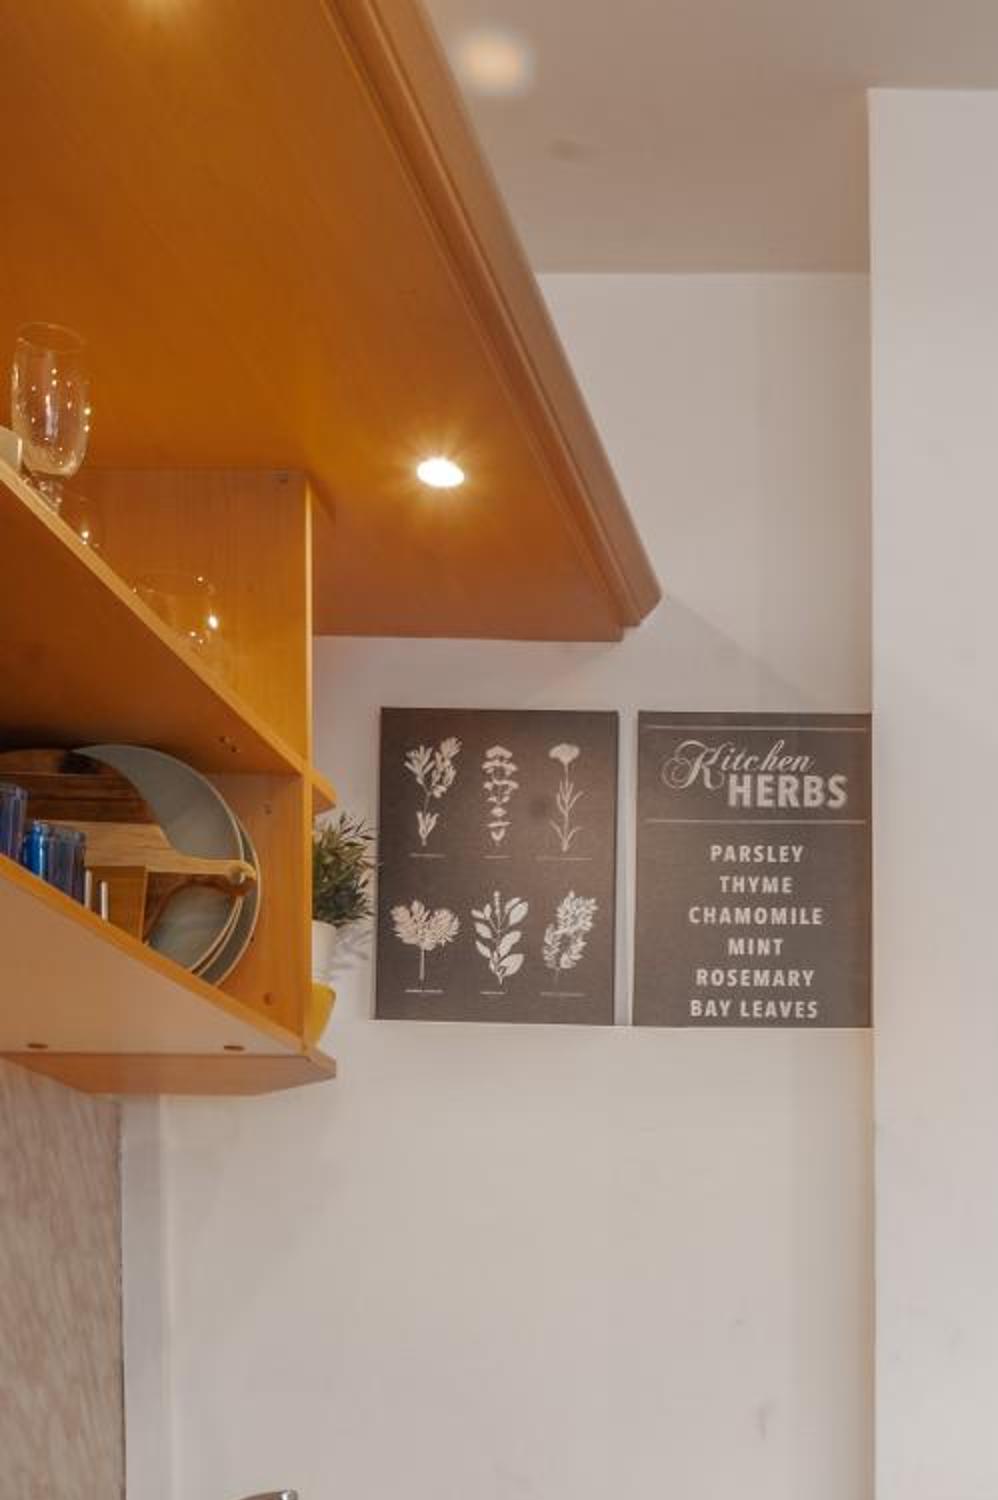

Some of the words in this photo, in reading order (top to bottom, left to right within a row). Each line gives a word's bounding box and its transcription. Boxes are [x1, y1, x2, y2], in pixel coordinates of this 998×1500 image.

[662, 739, 814, 790] Kitchen
[728, 774, 848, 808] HERBS
[710, 844, 804, 863] PARSLEY
[719, 875, 793, 893] THYME
[688, 906, 823, 925] CHAMOMILE
[728, 937, 784, 956] MINT
[695, 968, 815, 987] ROSEMARY
[690, 999, 731, 1017] BAY
[740, 1000, 818, 1018] LEAVES
